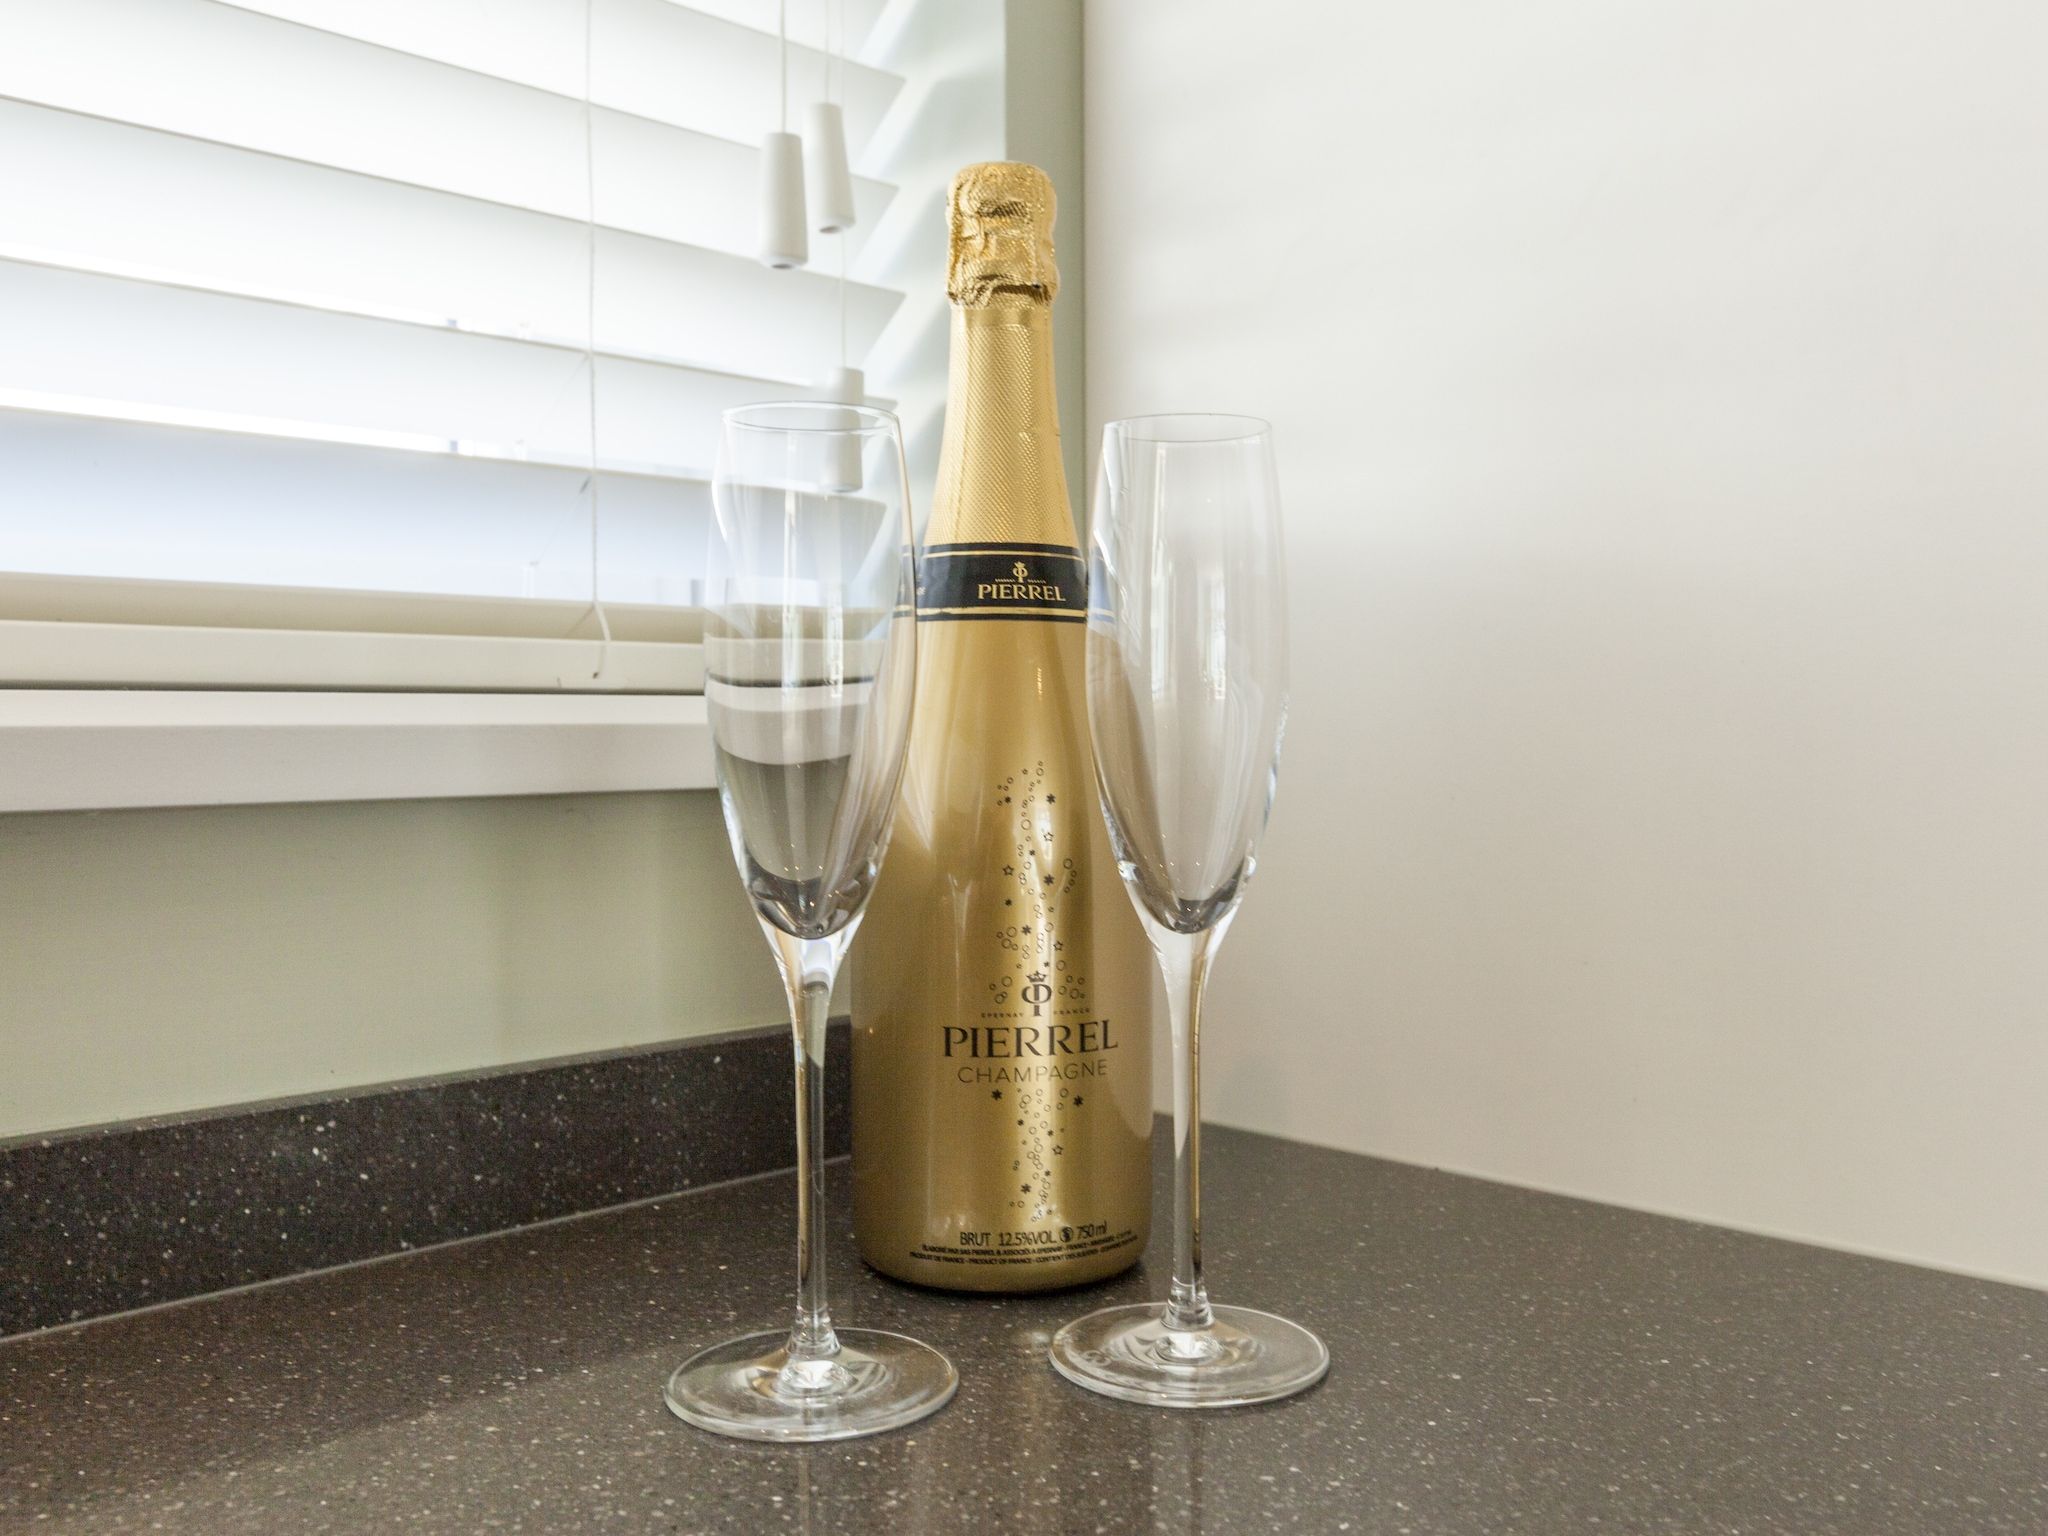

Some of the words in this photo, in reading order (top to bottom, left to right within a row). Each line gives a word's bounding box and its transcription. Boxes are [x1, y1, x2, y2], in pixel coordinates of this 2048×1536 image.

[978, 584, 1066, 602] PIERREL
[943, 1019, 1119, 1059] PIERREL
[957, 1058, 1108, 1084] CHAMPAGNE
[960, 1231, 991, 1246] BRUT
